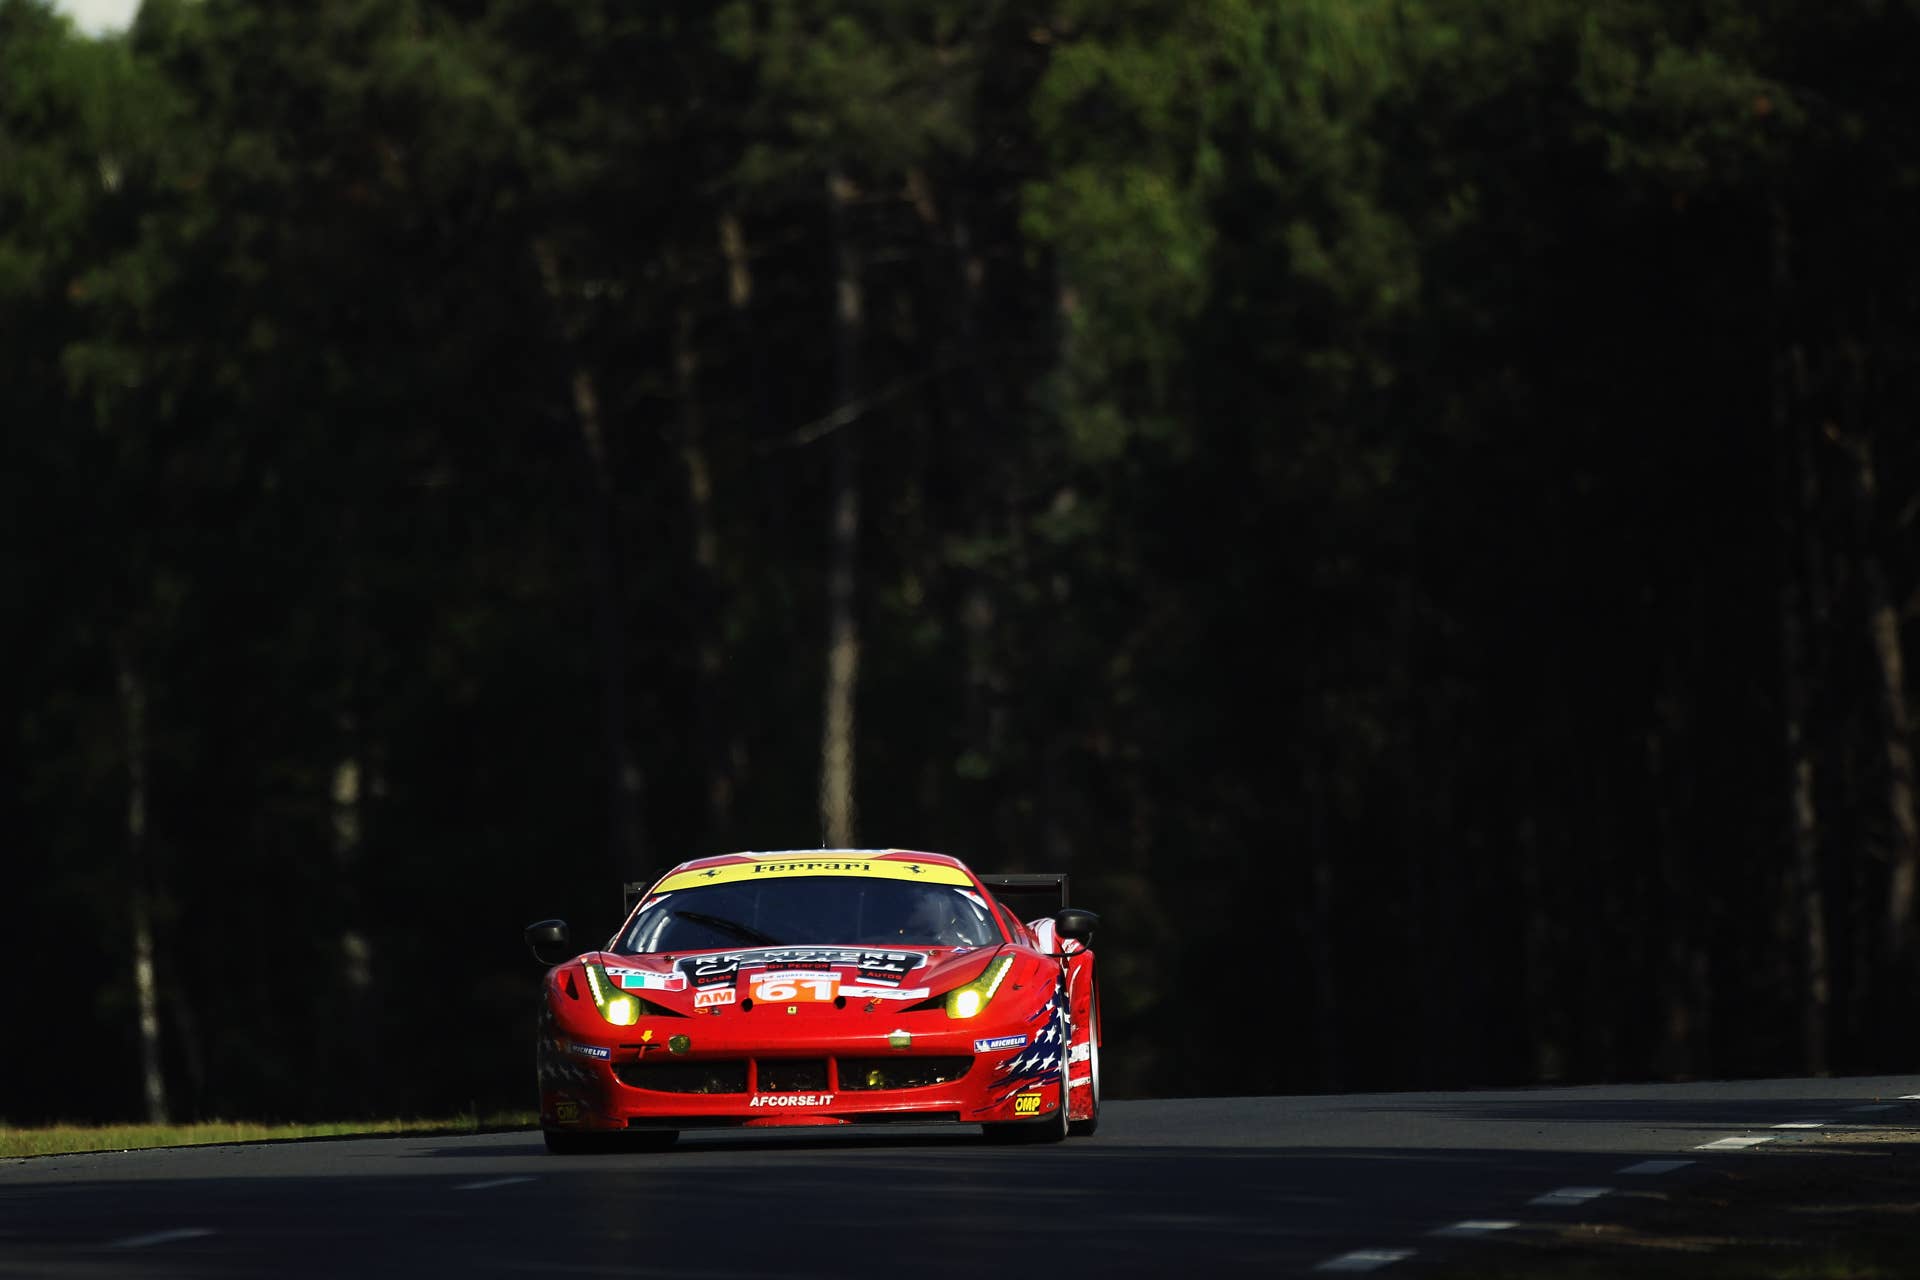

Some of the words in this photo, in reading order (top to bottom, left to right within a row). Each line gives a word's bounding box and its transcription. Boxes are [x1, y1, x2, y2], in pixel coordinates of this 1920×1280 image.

[755, 863, 870, 873] Ferrari
[696, 954, 744, 965] RK
[764, 951, 906, 961] MOTORS
[755, 979, 832, 1001] 61
[698, 991, 732, 1005] AM
[990, 1037, 1026, 1048] MICHELIN
[749, 1095, 834, 1107] AFCORSE.IT
[1015, 1096, 1041, 1112] OMP
